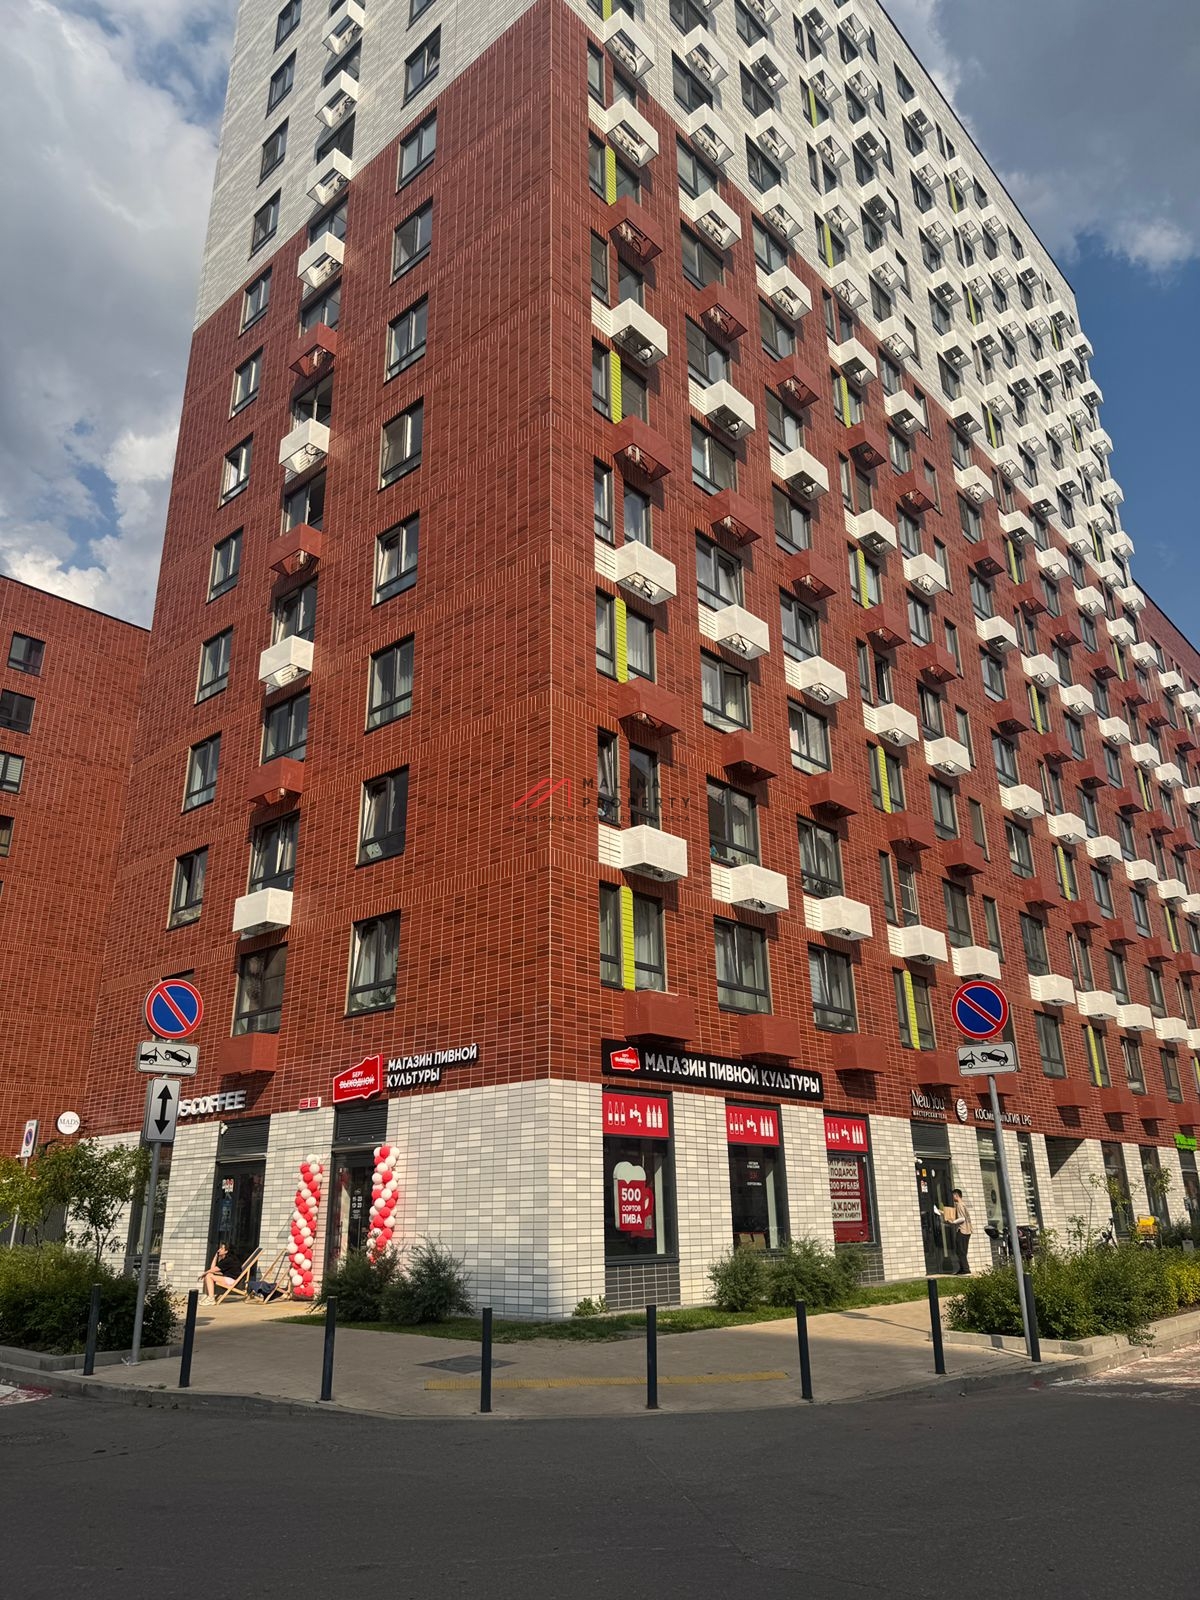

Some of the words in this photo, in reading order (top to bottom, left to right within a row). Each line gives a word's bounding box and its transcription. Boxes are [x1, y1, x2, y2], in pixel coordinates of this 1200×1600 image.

[388, 1053, 432, 1072] МАГАЗИН
[434, 1043, 477, 1065] ПИВНОЙ
[386, 1067, 440, 1088] КУЛЬТУРЫ
[645, 1052, 707, 1079] МАГАЗИН
[709, 1061, 759, 1085] ПИВНОЙ
[761, 1069, 820, 1093] КУЛЬТУРЫ
[621, 1187, 642, 1202] 500
[831, 1201, 860, 1212] АЖДОМУ
[621, 1213, 643, 1225] ПИВА
